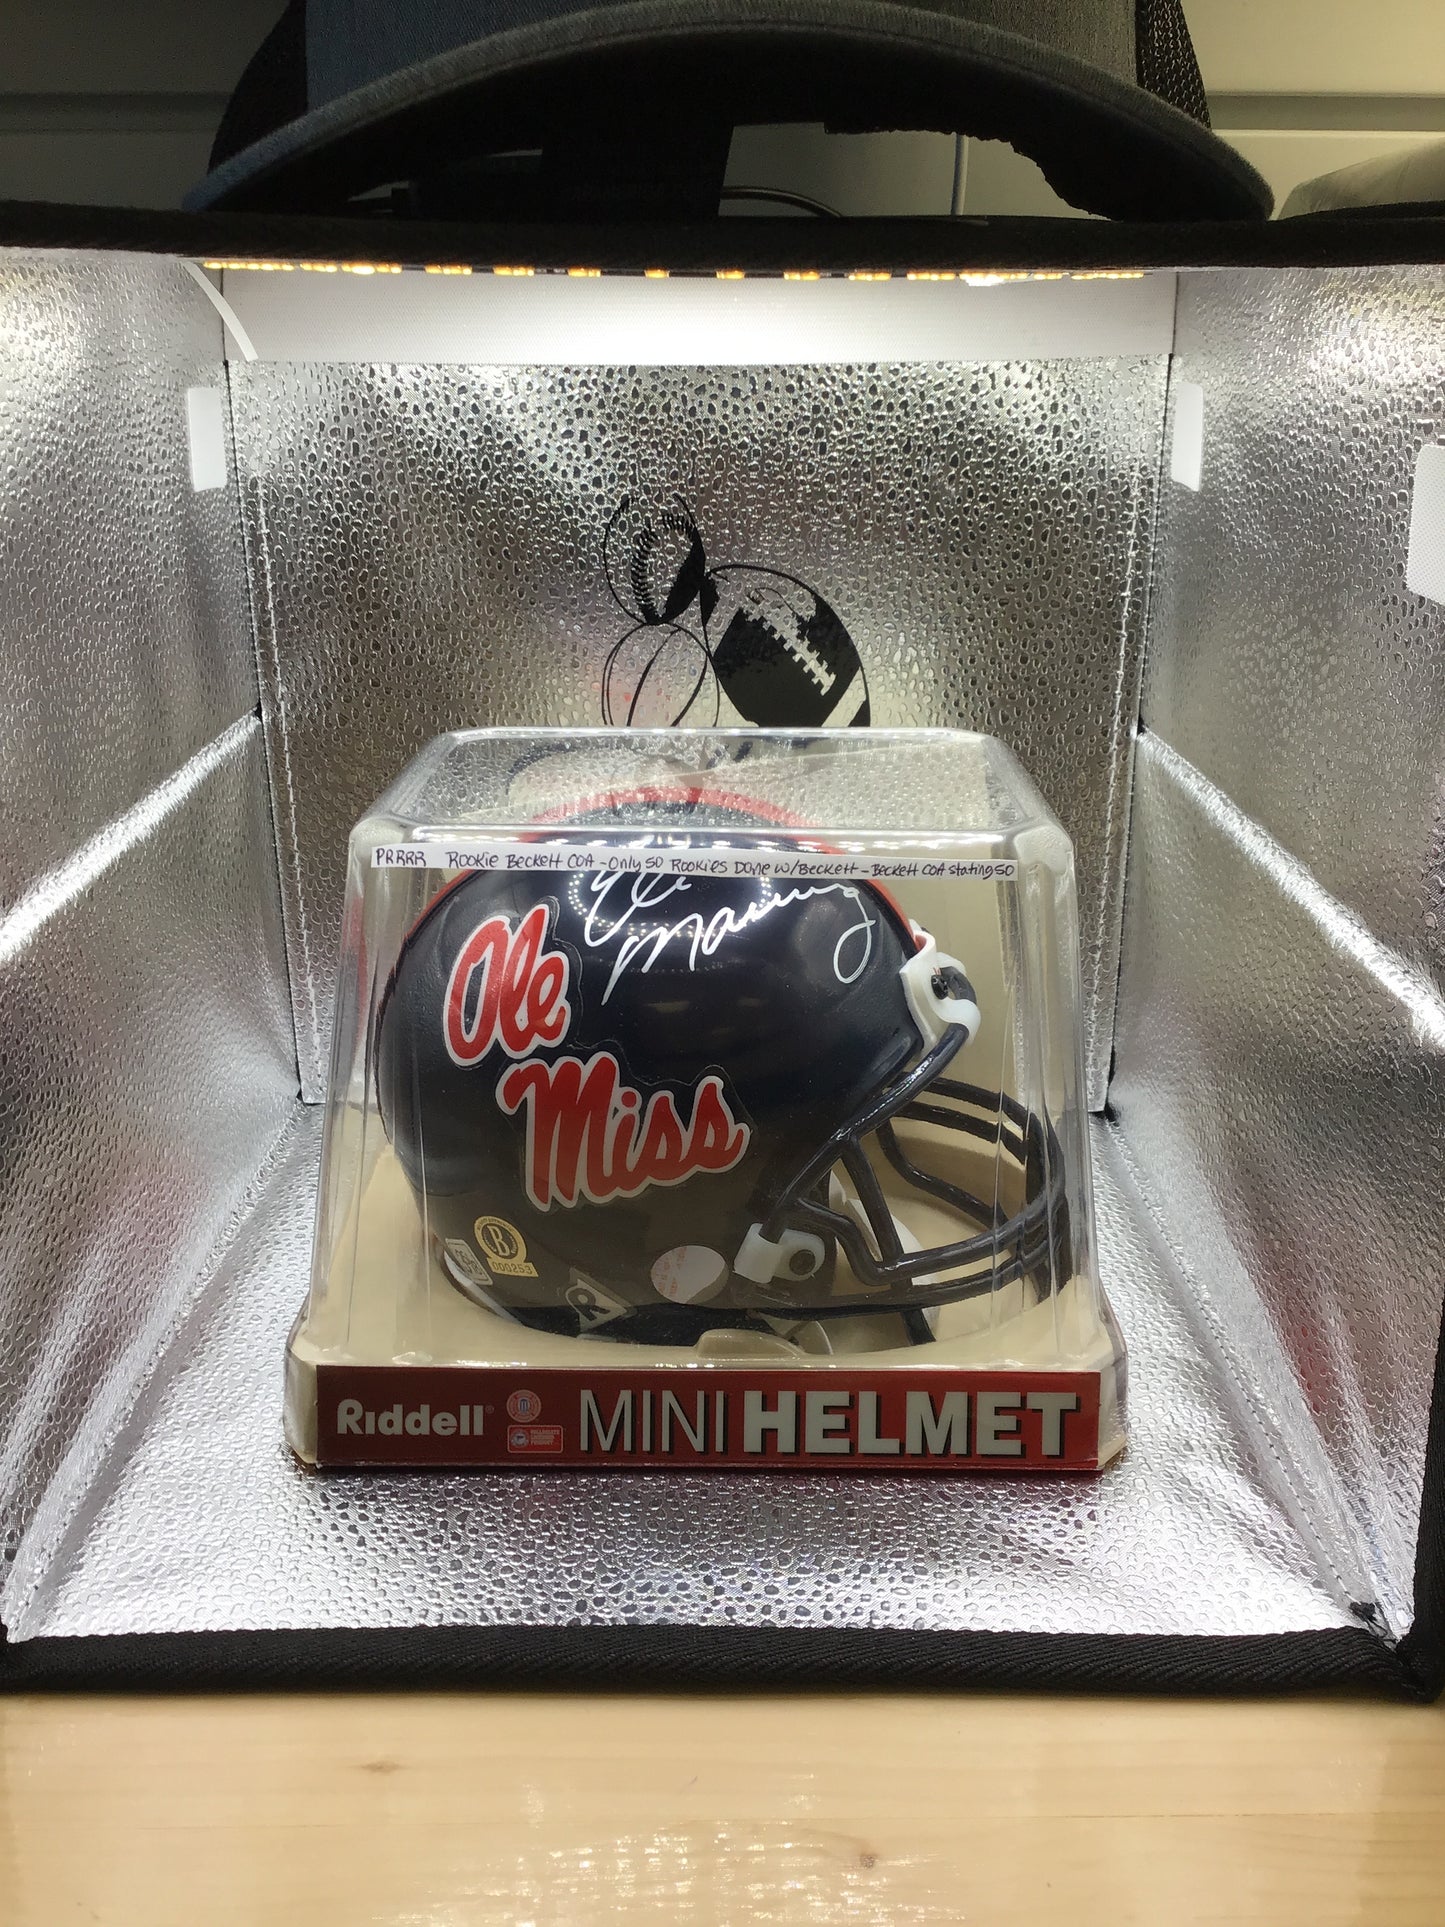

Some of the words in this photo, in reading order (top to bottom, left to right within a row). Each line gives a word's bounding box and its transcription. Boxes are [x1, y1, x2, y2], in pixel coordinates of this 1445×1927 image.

[566, 853, 596, 869] COA
[921, 863, 947, 876] COA
[443, 903, 572, 1067] Ole
[495, 1051, 750, 1212] Miss
[579, 1389, 725, 1453] MINI
[743, 1390, 1080, 1457] HELMET
